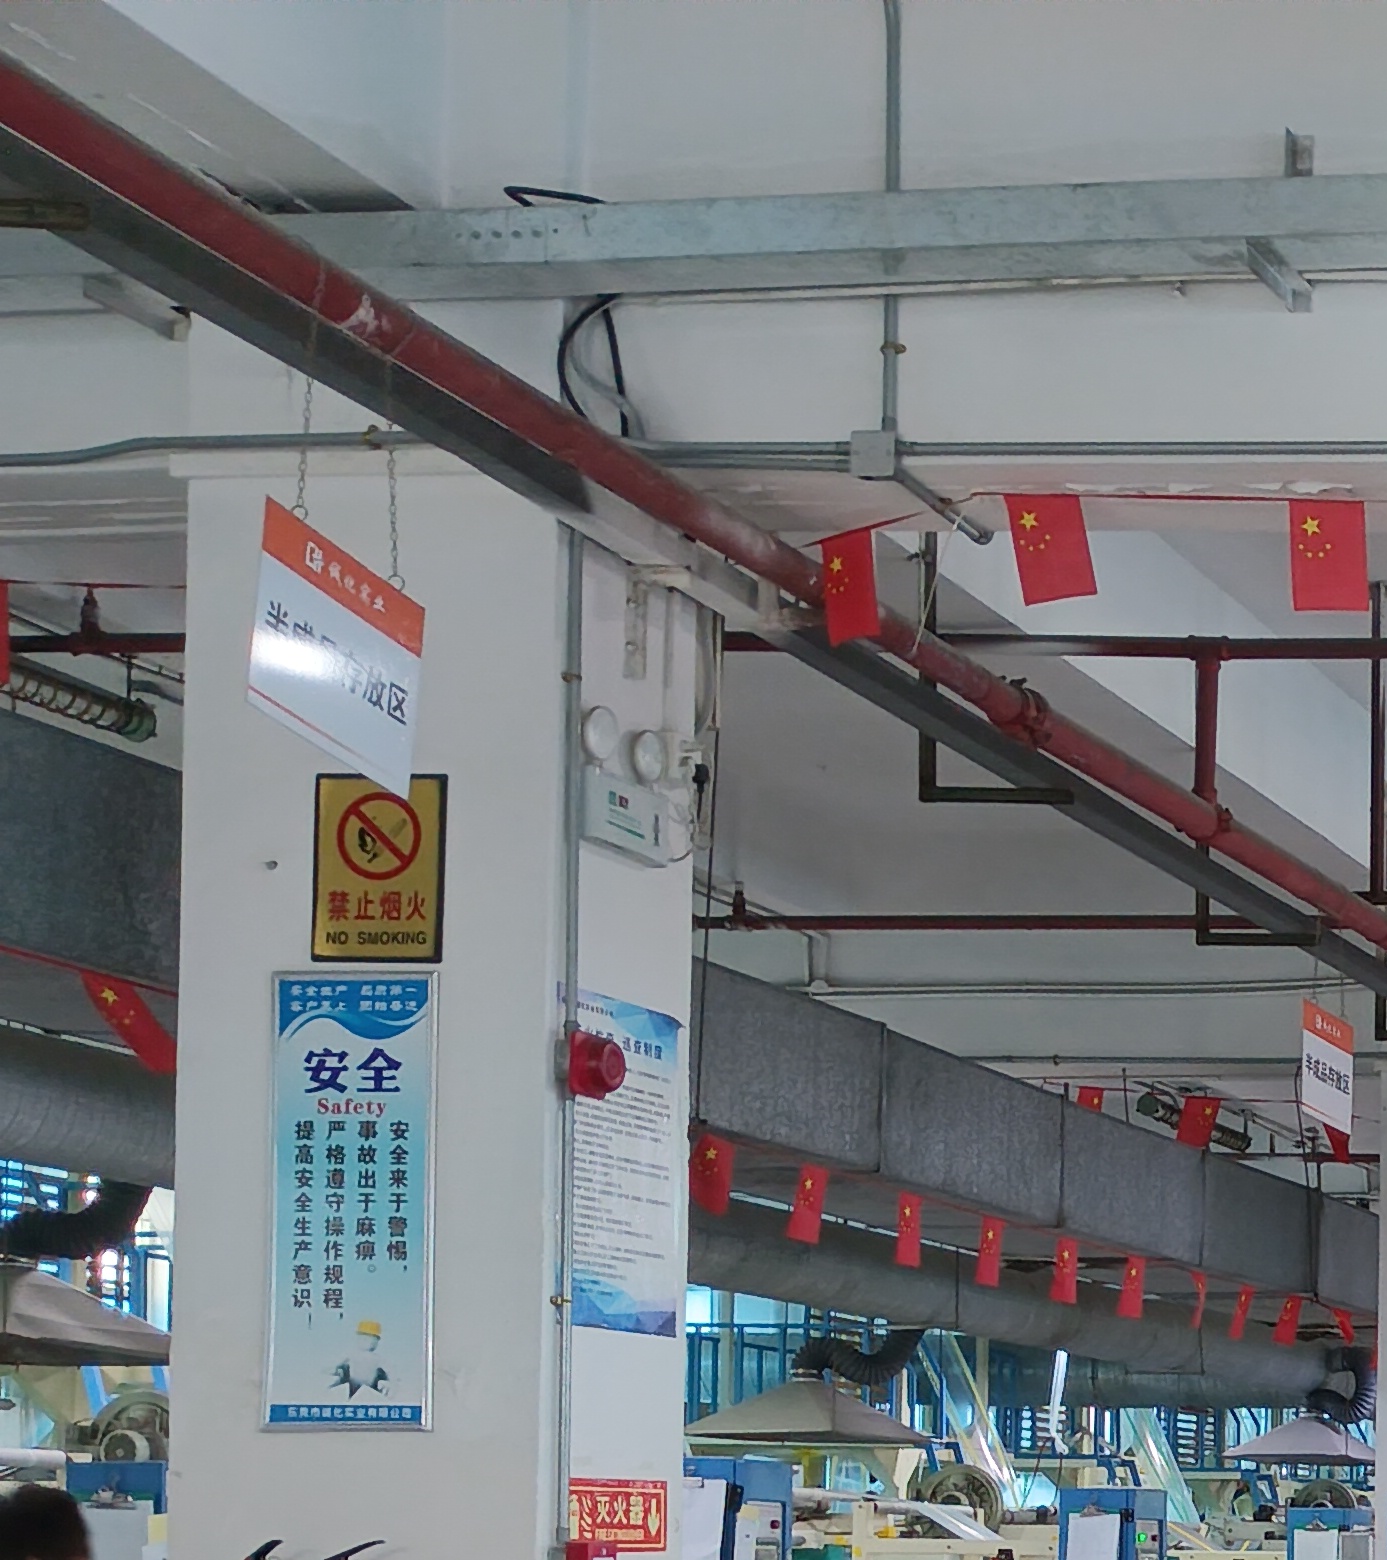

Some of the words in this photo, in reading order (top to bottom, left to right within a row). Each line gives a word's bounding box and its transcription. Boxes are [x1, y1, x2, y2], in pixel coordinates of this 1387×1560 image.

[264, 600, 409, 726] 半存放区
[327, 890, 427, 922] 禁止烟火
[325, 931, 349, 945] NO
[357, 931, 428, 945] SMOKING
[303, 1047, 403, 1094] 安全
[317, 1098, 387, 1118] Safety
[596, 1495, 644, 1525] 灭火器
